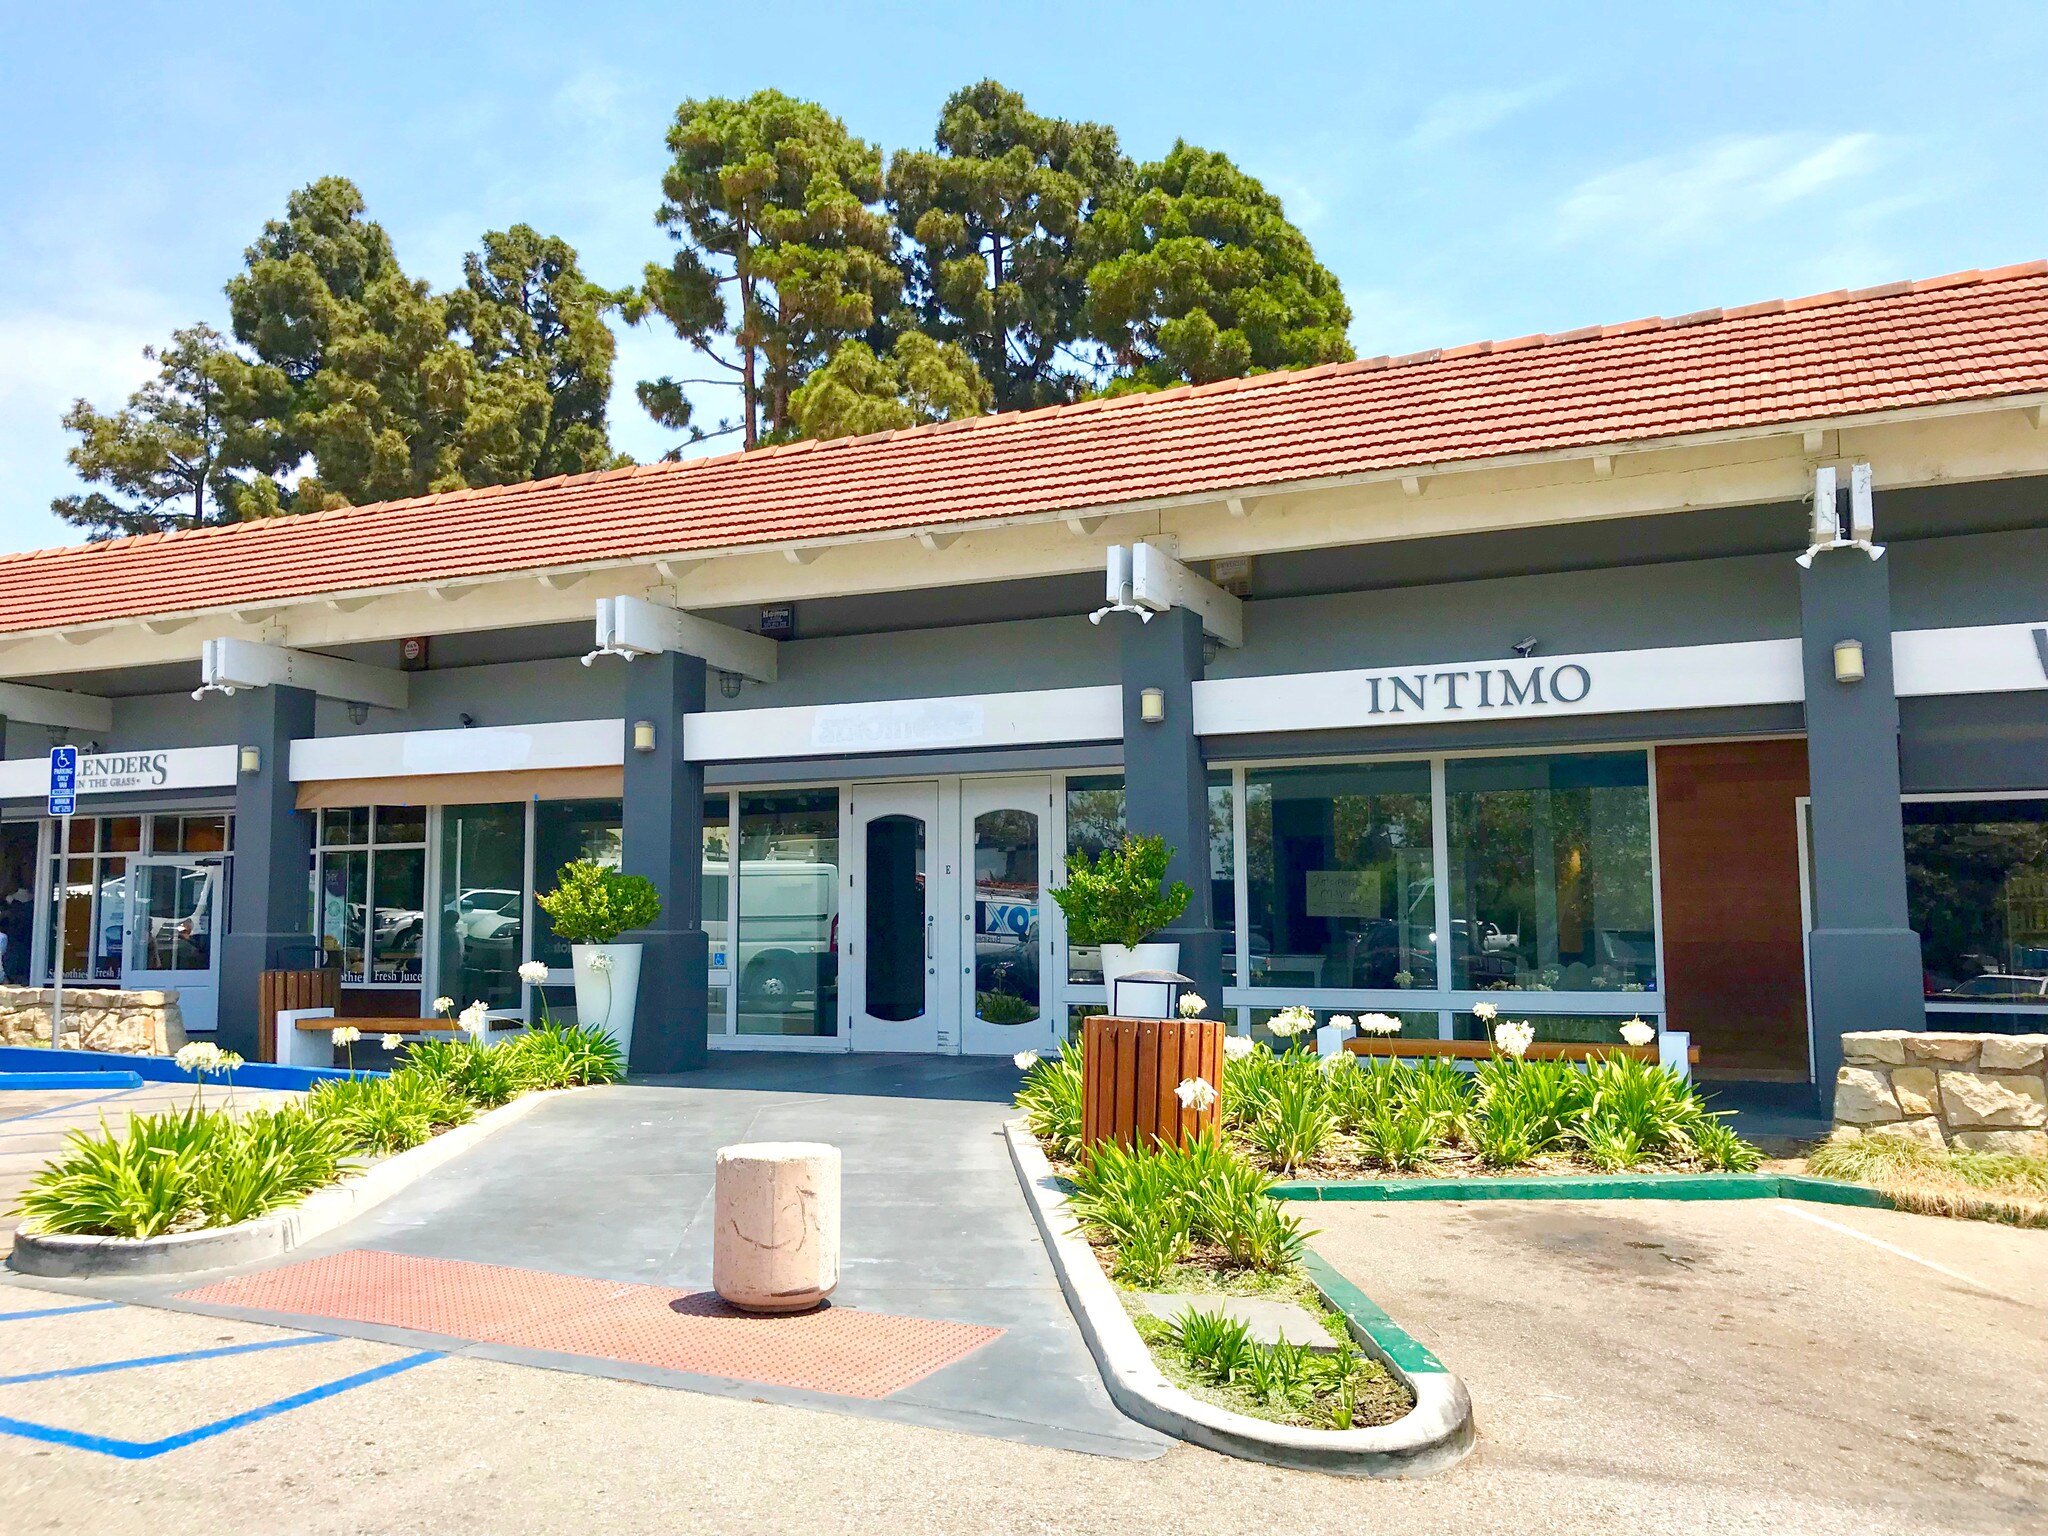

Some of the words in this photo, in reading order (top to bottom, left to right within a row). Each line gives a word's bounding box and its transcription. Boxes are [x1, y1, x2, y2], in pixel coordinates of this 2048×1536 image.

[1365, 664, 1591, 714] INTIMO
[89, 779, 107, 788] THE
[945, 864, 951, 874] E
[95, 966, 115, 978] Fresh
[374, 969, 397, 981] Fresh
[400, 970, 423, 983] Juice
